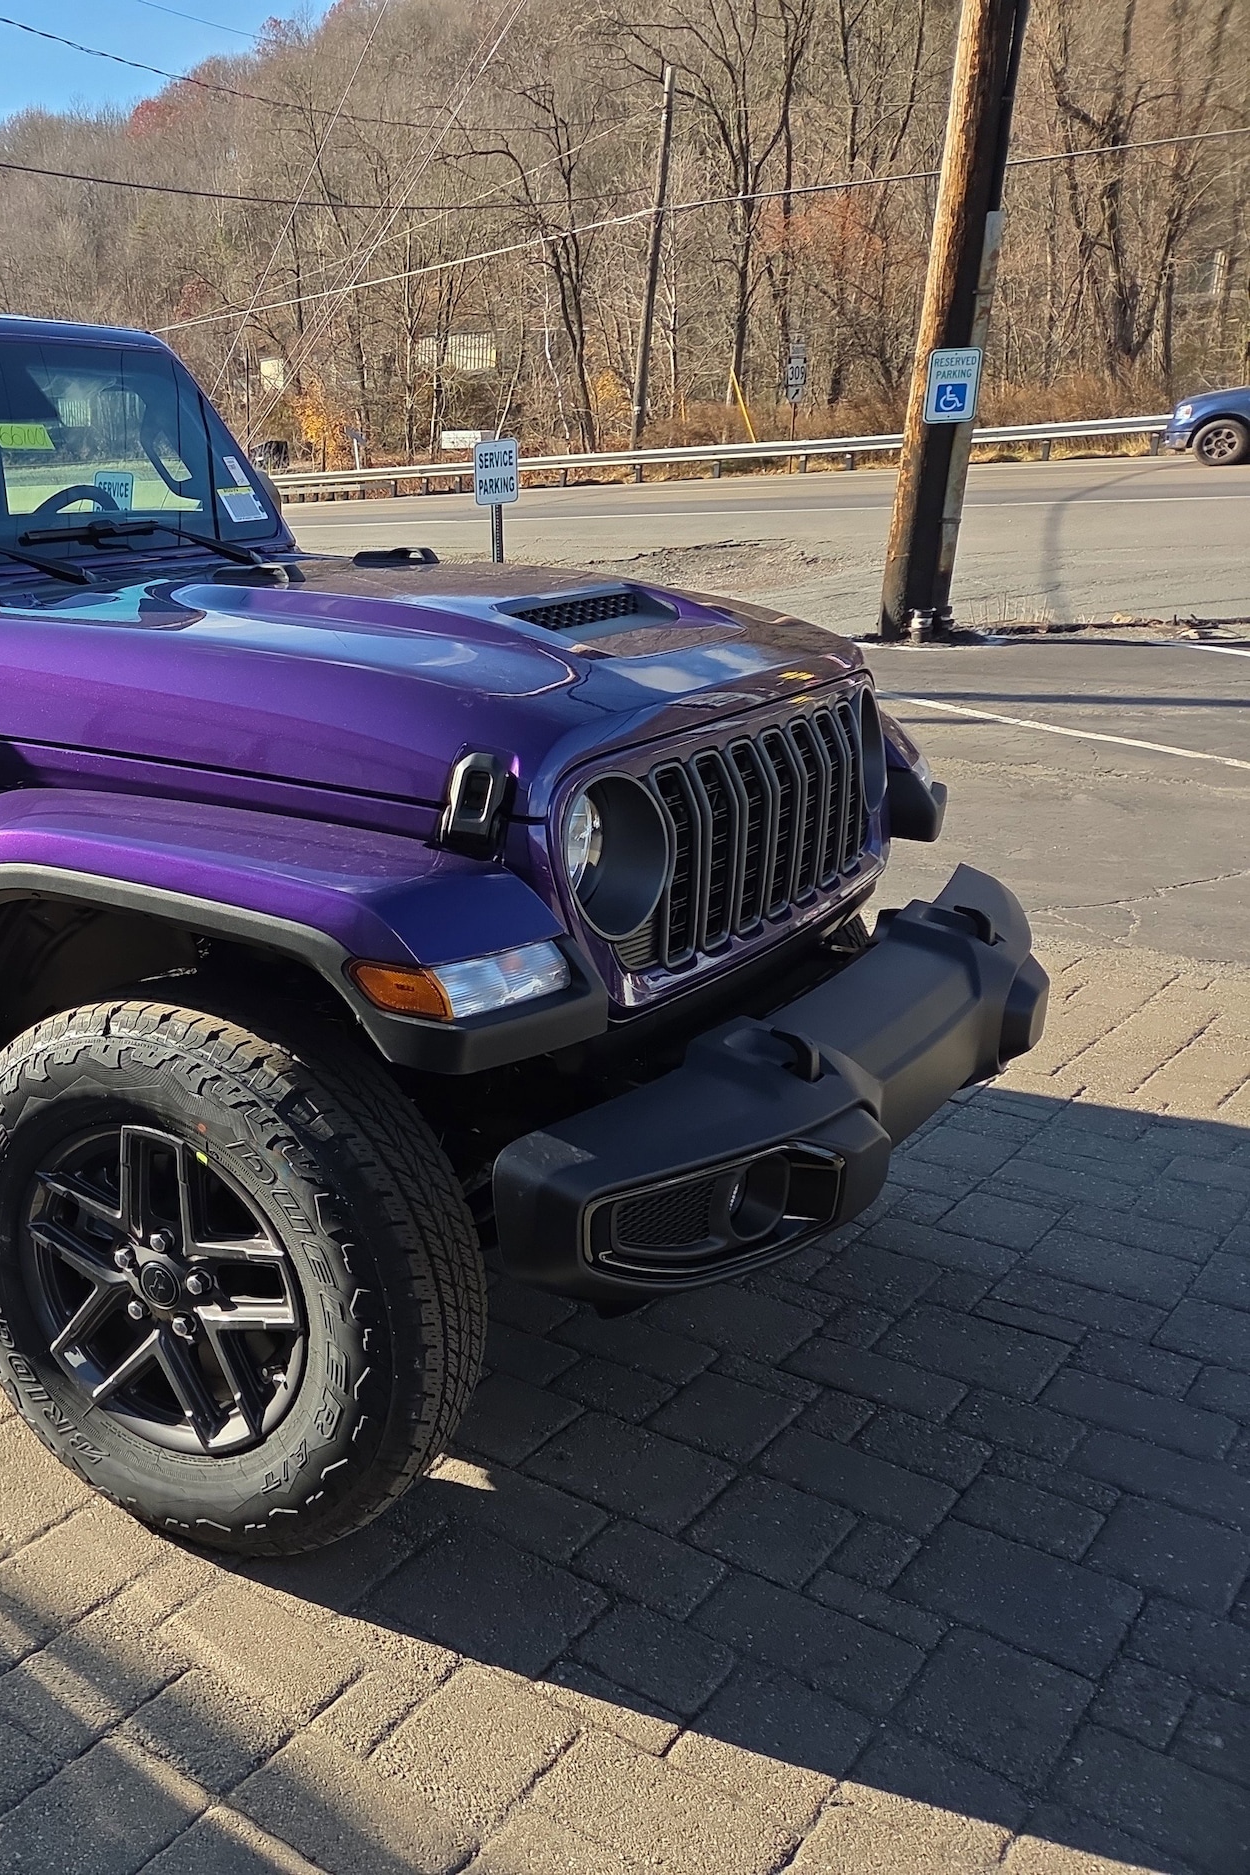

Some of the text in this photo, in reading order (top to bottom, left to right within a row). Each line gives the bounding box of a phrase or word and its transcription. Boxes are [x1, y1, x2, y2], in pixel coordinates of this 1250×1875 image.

[934, 356, 977, 368] RESERVED
[789, 366, 806, 381] 309
[935, 369, 972, 380] PARKING
[478, 450, 513, 469] SERVICE
[478, 476, 515, 495] PARKING
[225, 1139, 351, 1440] DUELER
